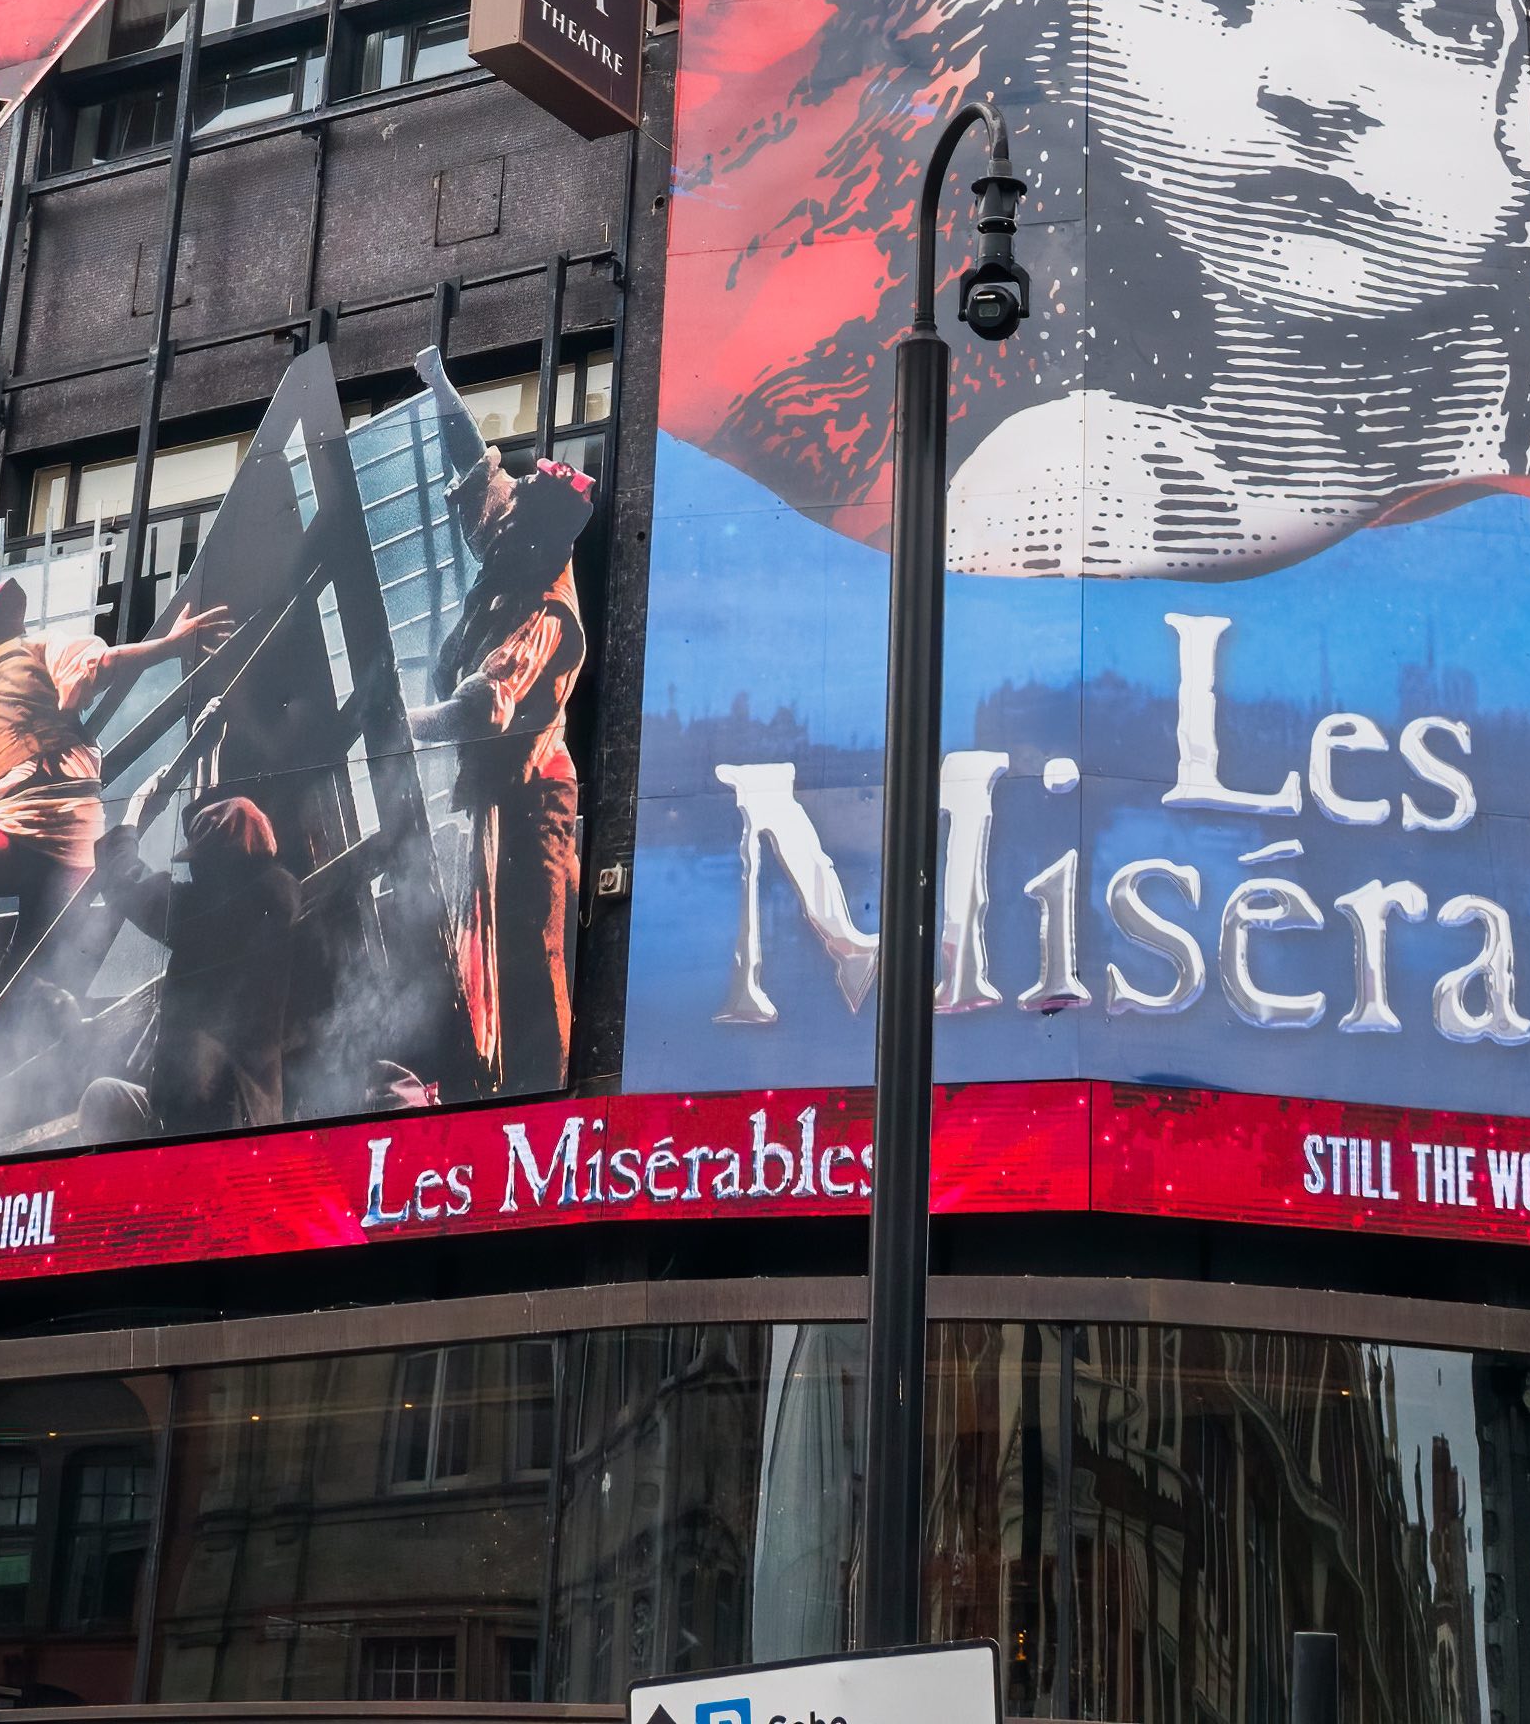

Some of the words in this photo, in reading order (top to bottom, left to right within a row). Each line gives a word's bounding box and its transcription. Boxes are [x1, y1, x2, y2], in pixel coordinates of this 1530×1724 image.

[1160, 611, 1478, 834] Les
[359, 1136, 473, 1229] Les
[1303, 1133, 1399, 1200] STILL
[1411, 1142, 1478, 1207] THE
